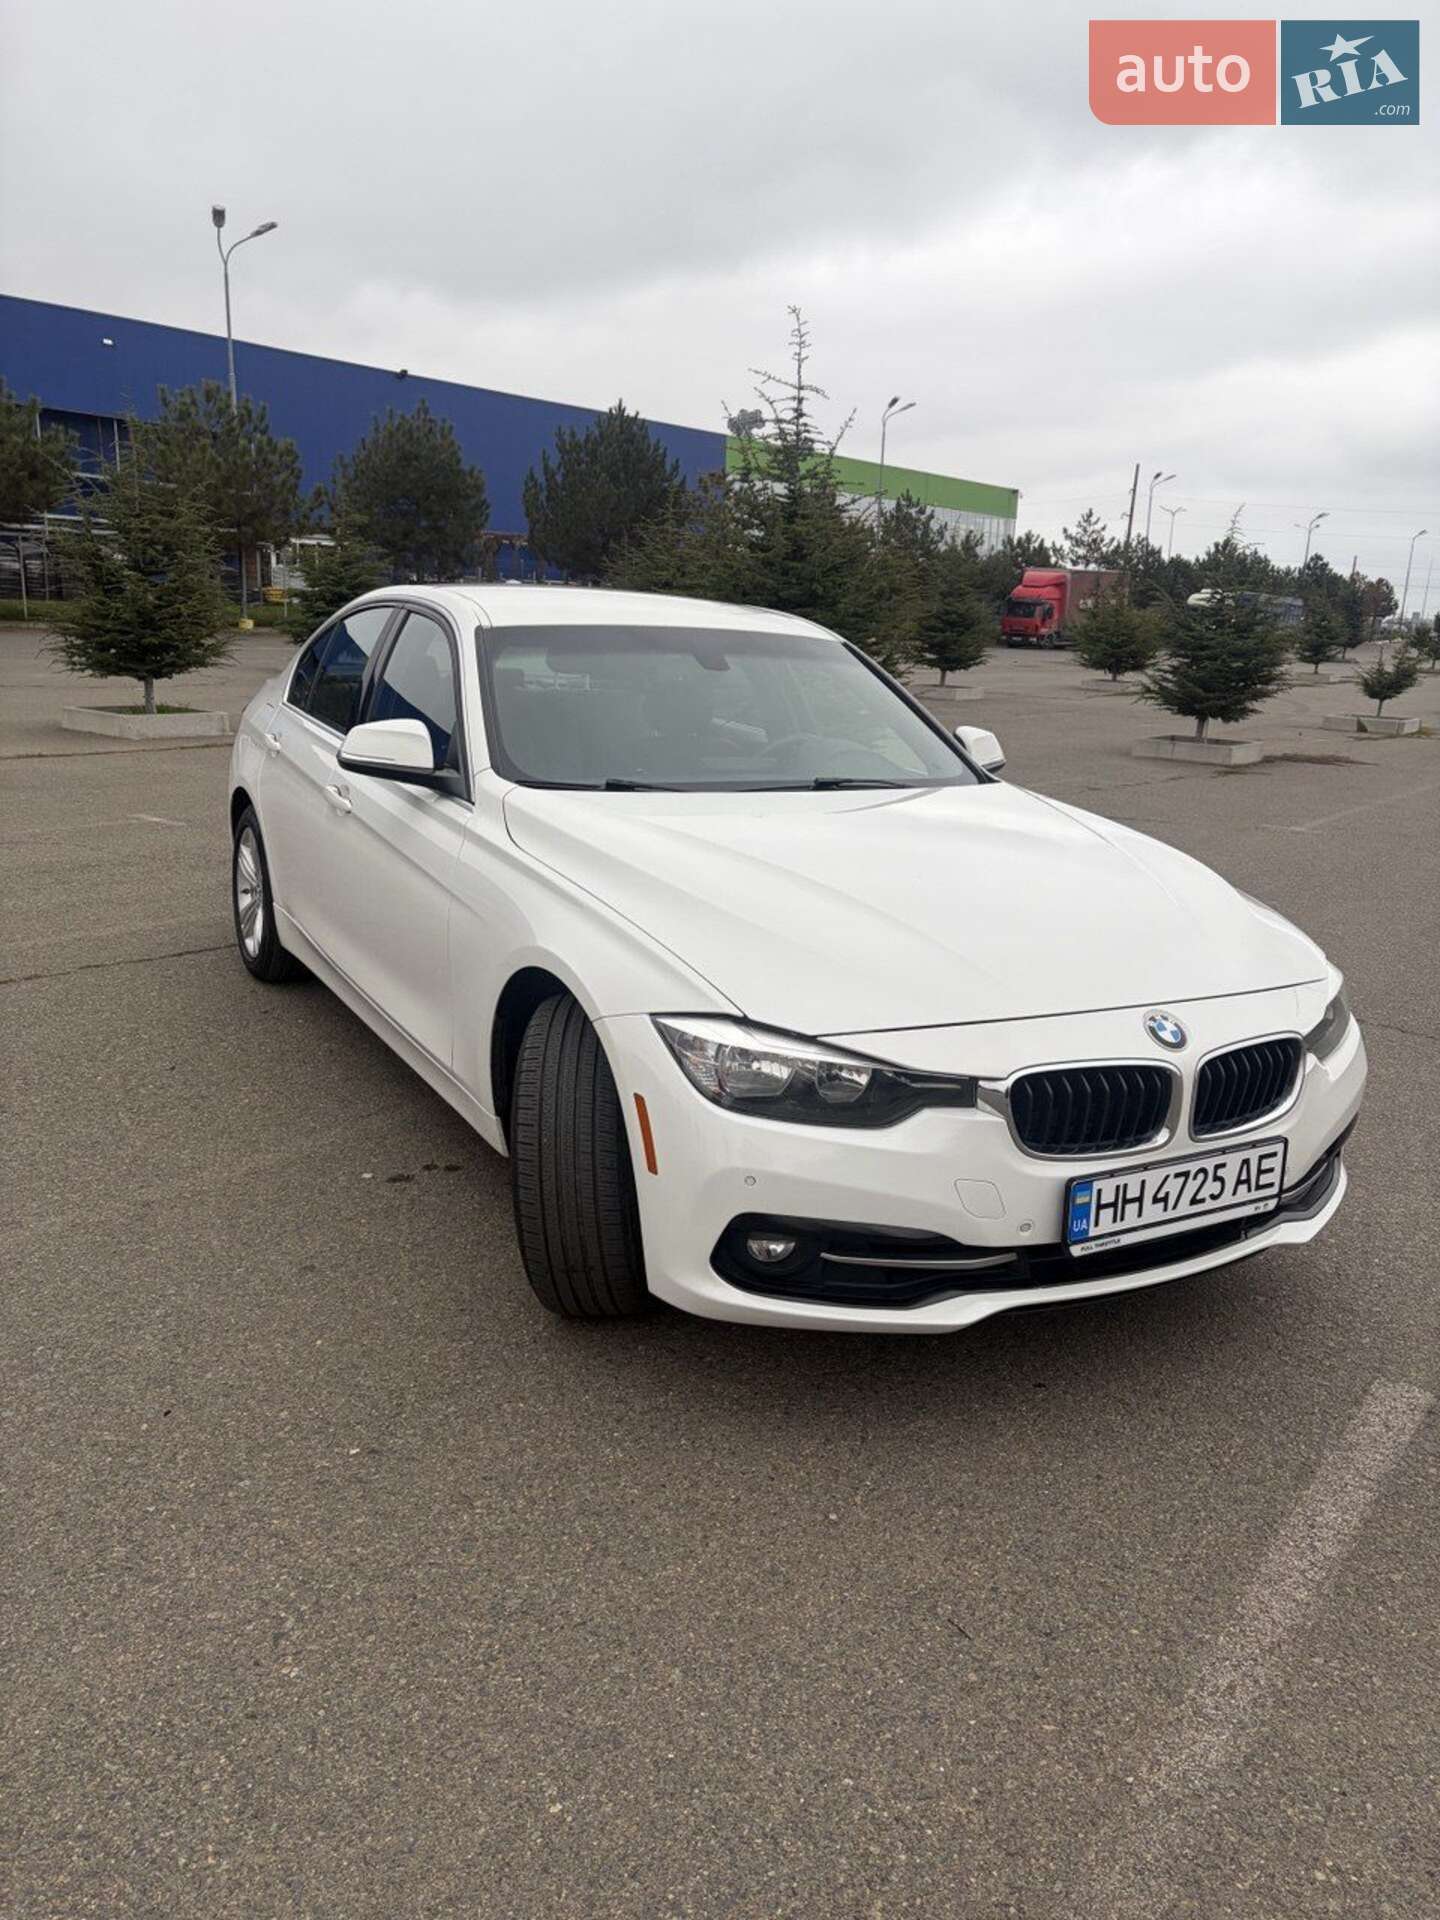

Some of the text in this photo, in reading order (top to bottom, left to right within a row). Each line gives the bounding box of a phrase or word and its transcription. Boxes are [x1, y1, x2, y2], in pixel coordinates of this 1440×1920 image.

[1095, 1152, 1278, 1227] HH 4725 AE
[1073, 1219, 1088, 1232] UA
